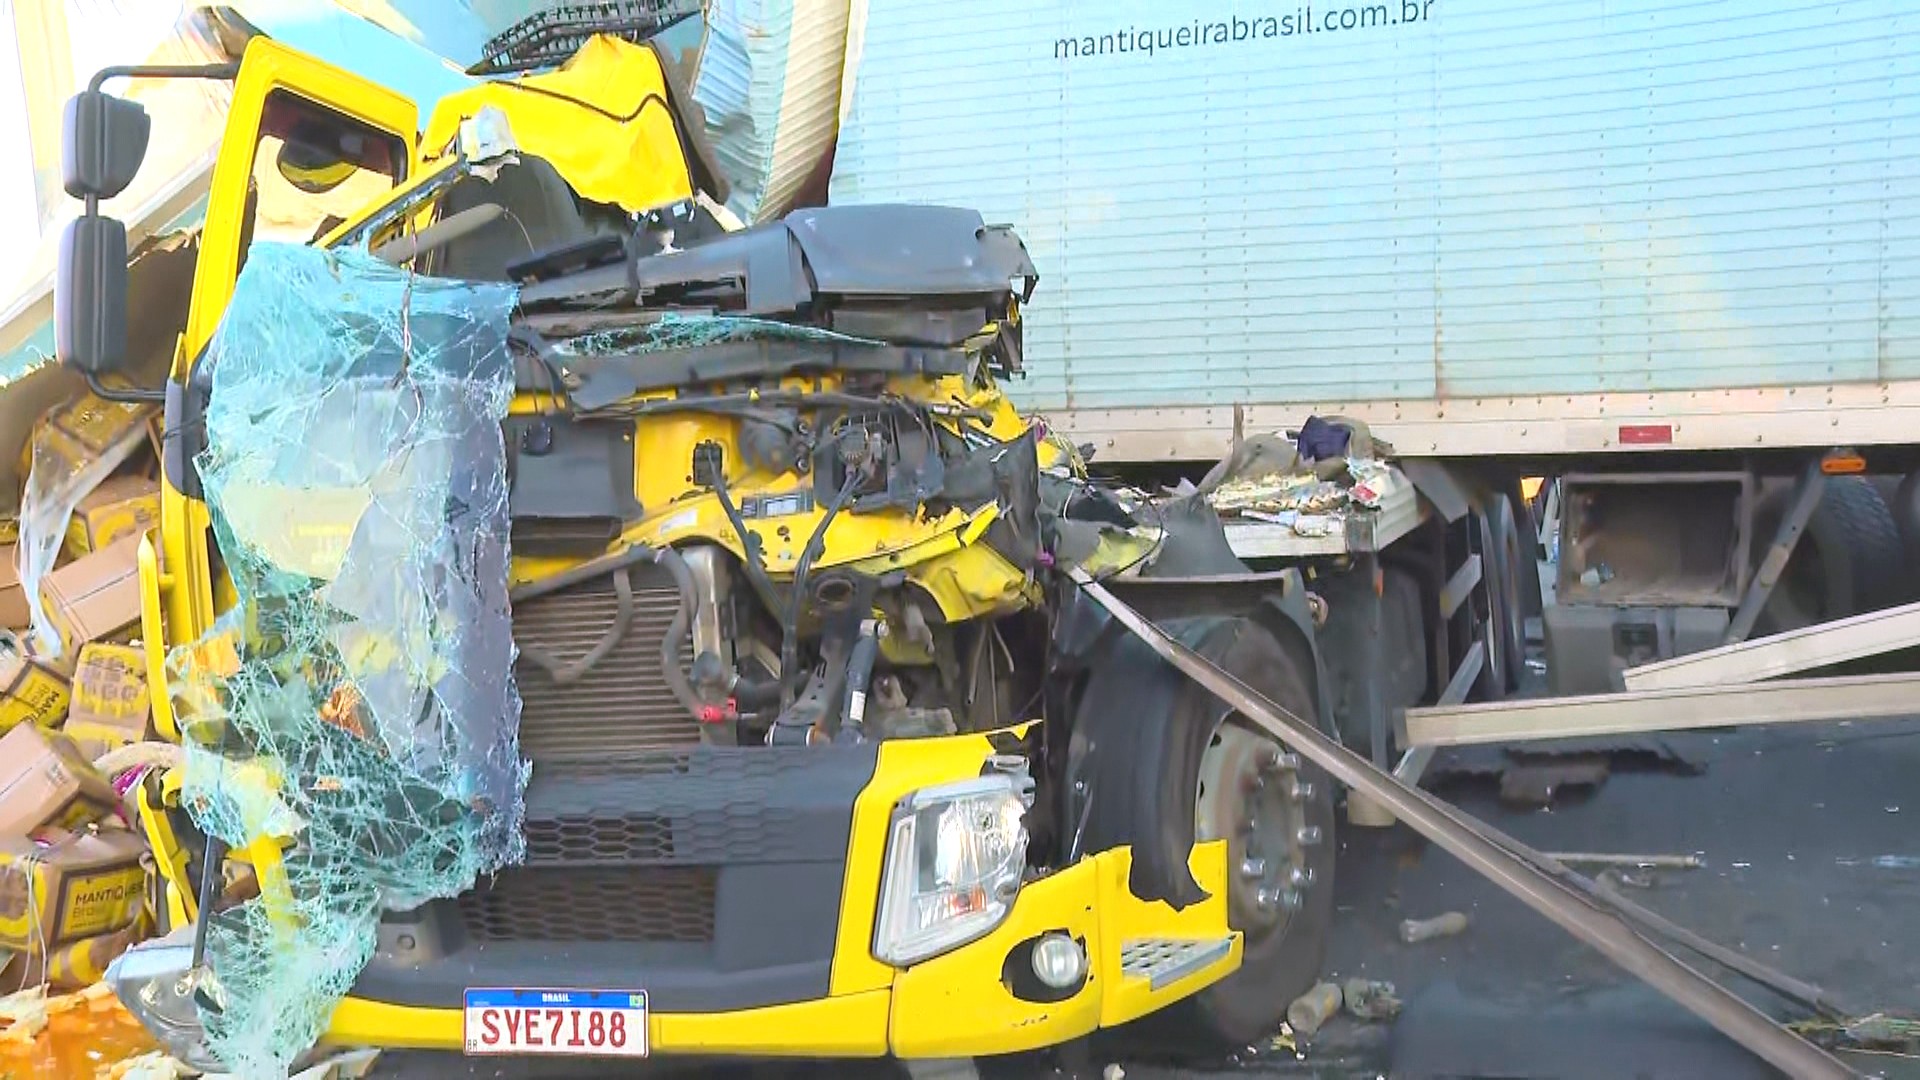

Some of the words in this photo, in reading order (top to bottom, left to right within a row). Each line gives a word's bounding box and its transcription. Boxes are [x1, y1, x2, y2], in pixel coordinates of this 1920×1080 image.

[1054, 0, 1434, 58] mantiqueirabrasil.com.br
[541, 993, 571, 1003] BRASIL
[481, 1009, 626, 1047] SYE7I88
